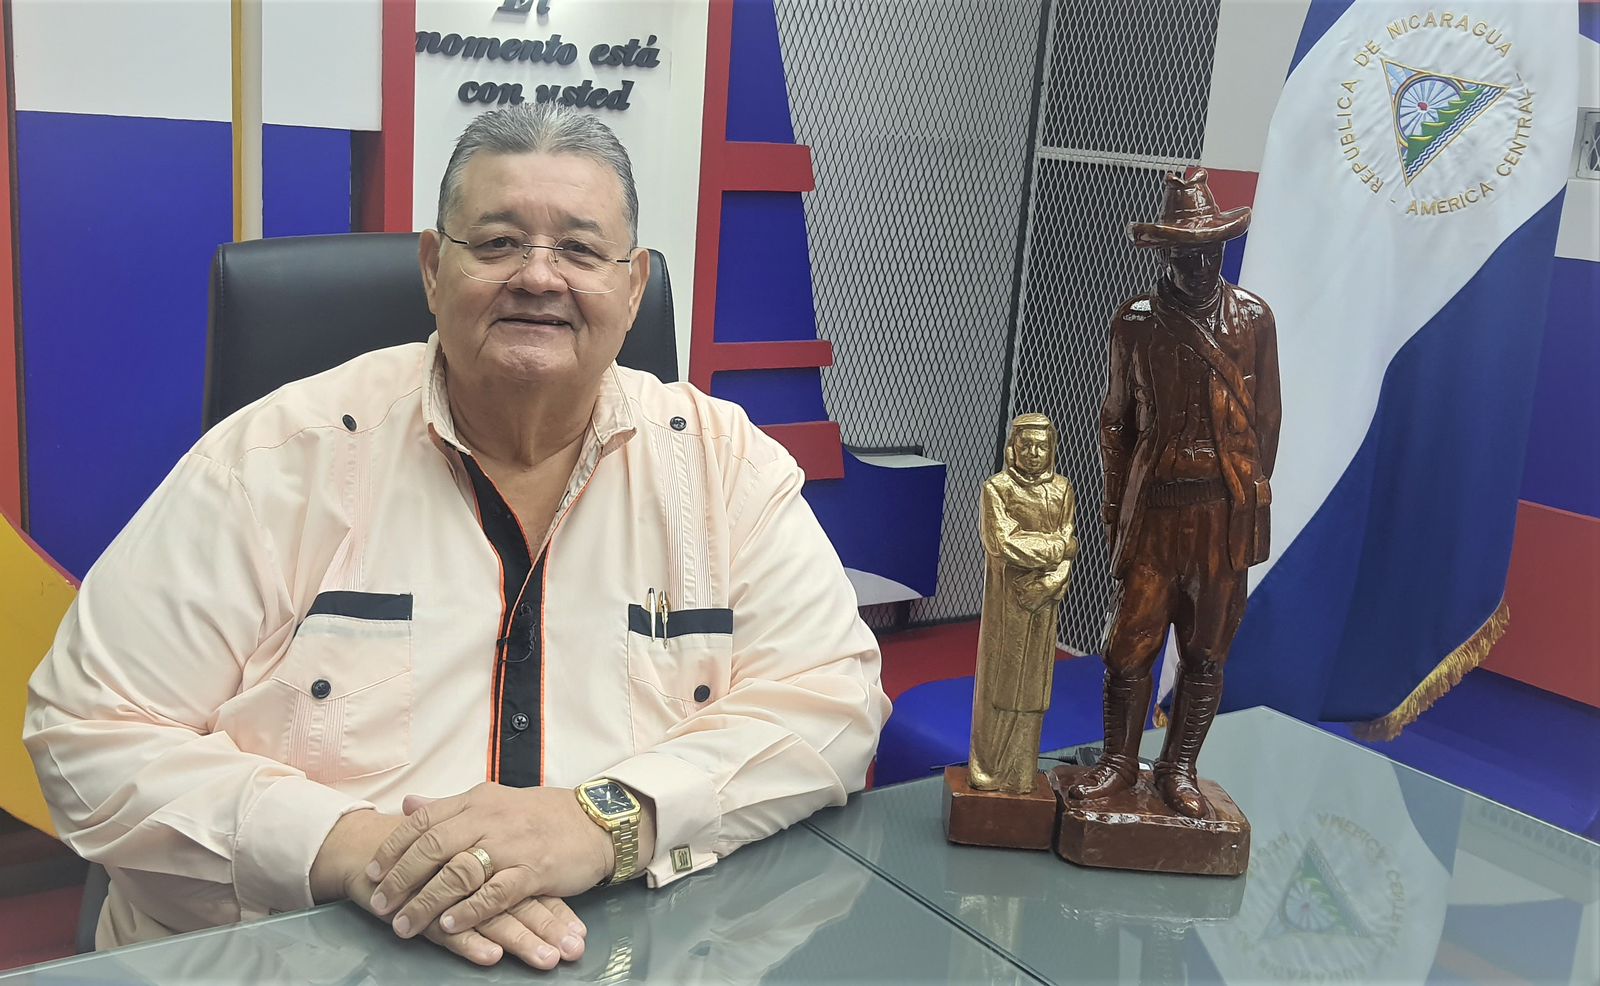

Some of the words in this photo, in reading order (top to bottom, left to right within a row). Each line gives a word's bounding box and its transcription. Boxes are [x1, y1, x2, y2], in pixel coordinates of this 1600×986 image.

[589, 35, 661, 68] está
[1354, 40, 1381, 67] DE
[1386, 12, 1512, 58] NICARAGUA
[458, 81, 525, 104] con
[535, 80, 635, 111] usted
[1337, 79, 1384, 193] REPUBLICA
[1406, 182, 1494, 216] AMERICA
[1496, 88, 1536, 177] CENTRAL
